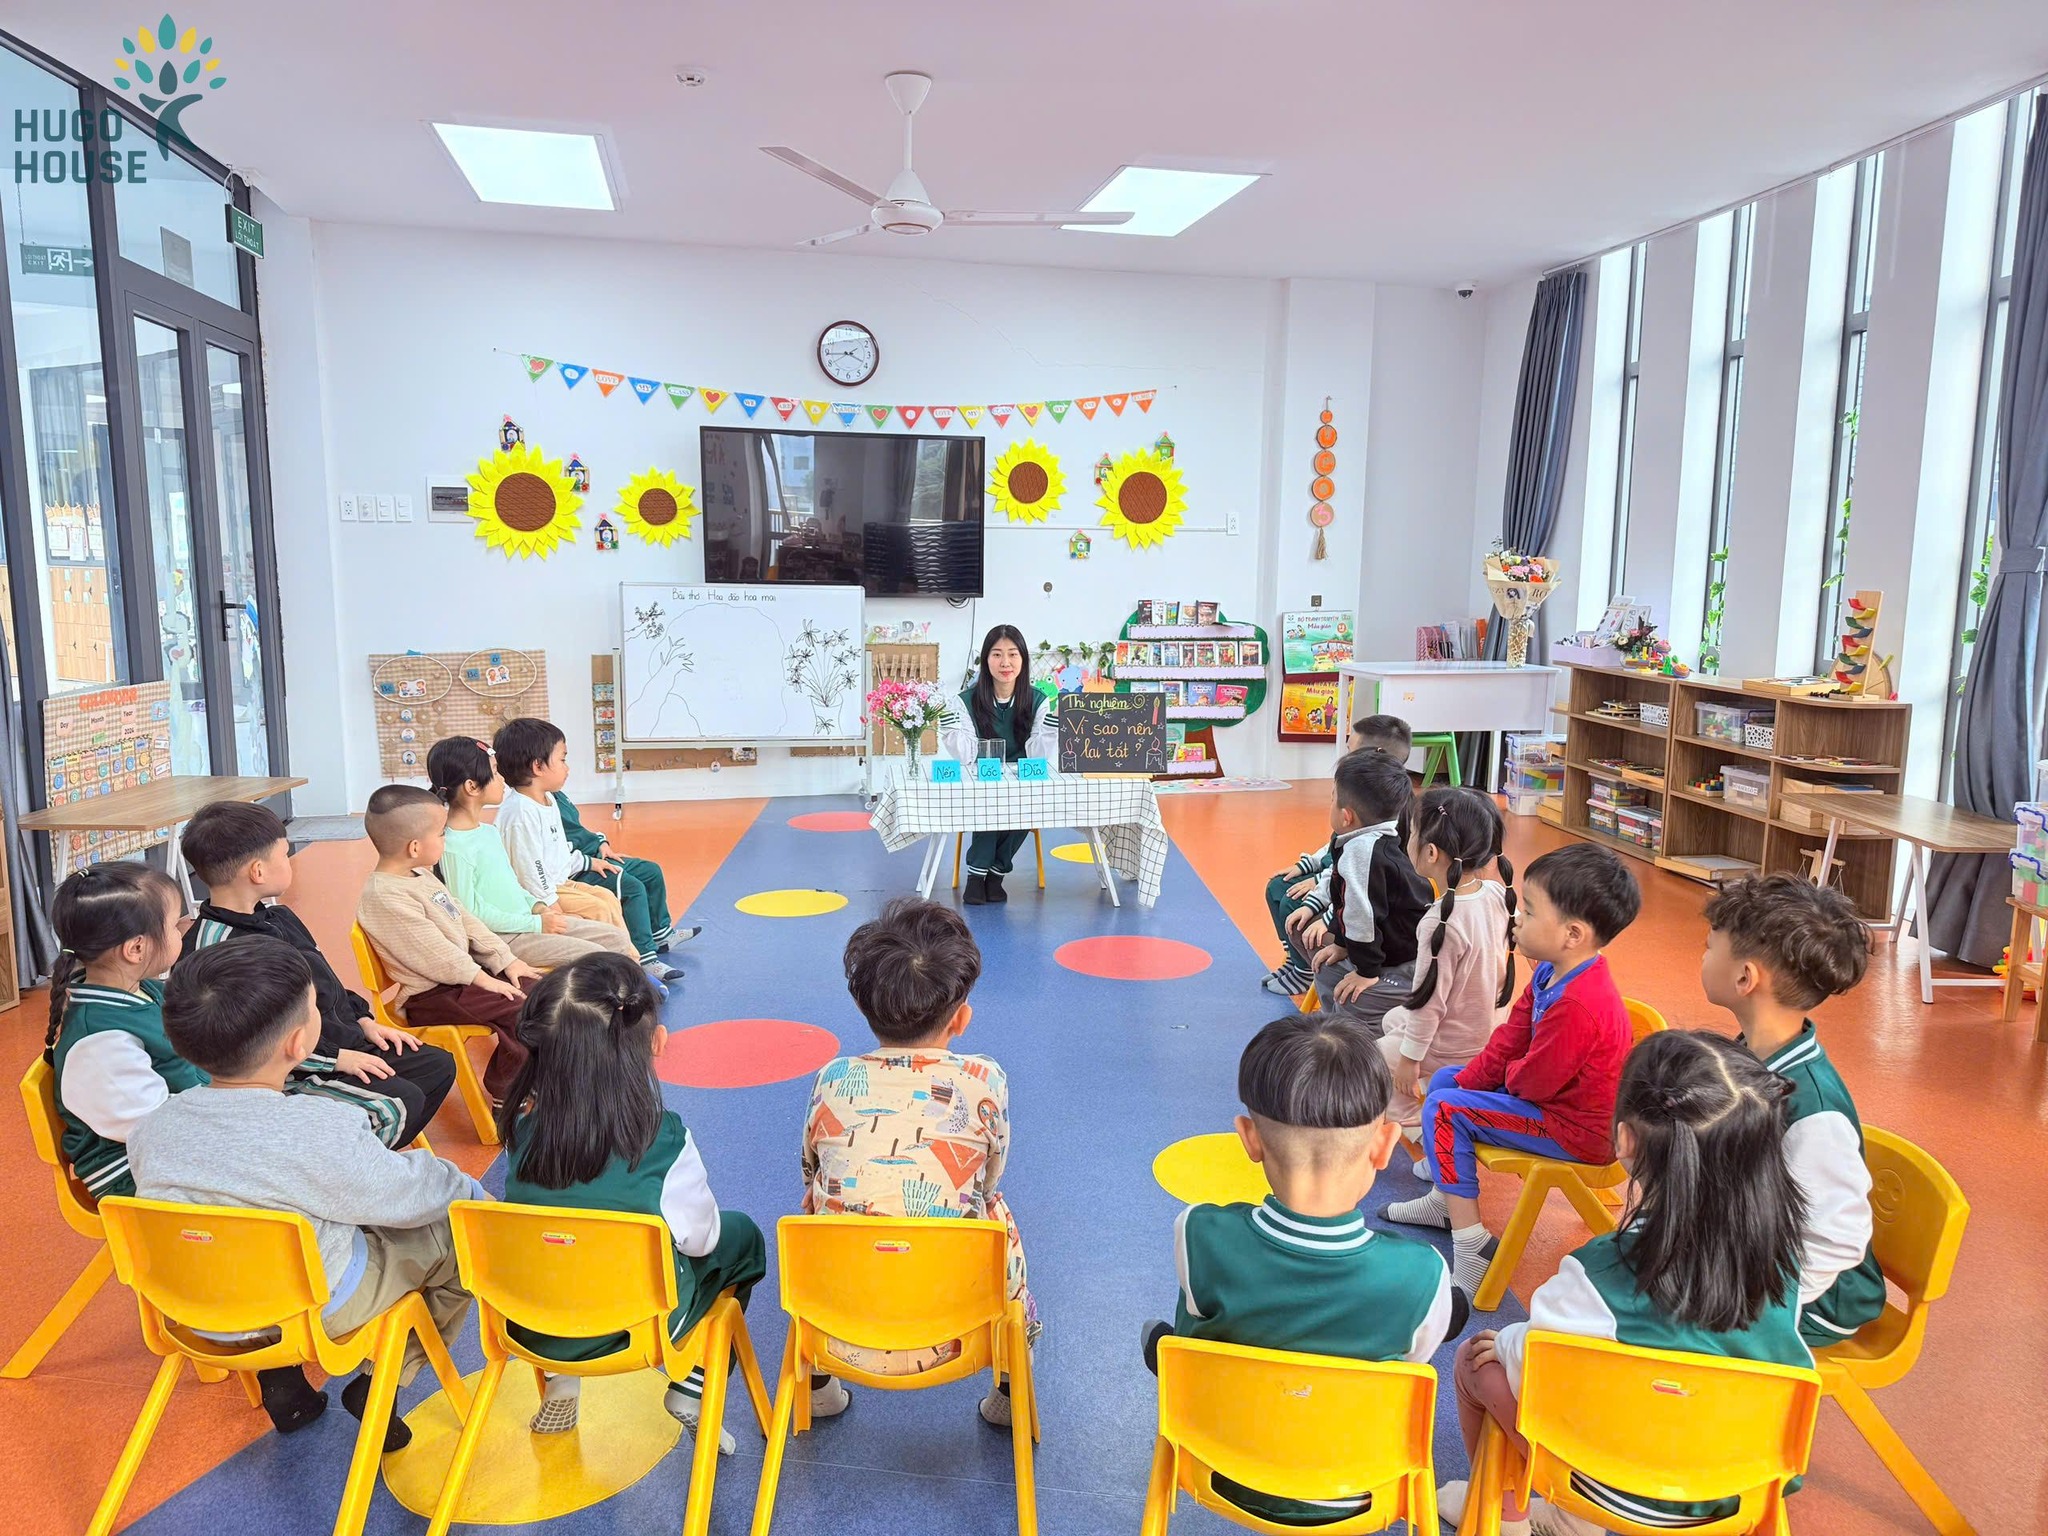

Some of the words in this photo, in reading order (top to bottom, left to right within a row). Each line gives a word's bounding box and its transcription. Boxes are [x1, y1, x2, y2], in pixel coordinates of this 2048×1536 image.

[237, 216, 255, 235] EXIT
[597, 375, 617, 384] LOVE
[638, 383, 650, 393] MY
[708, 589, 724, 601] Hoa
[744, 589, 757, 601] hoa
[761, 594, 777, 602] mai
[1062, 693, 1090, 709] Thí
[123, 710, 134, 718] Year
[1093, 724, 1119, 736] sao
[1127, 719, 1154, 736] nến
[936, 766, 956, 780] Nến
[980, 764, 998, 778] Cốc
[1020, 763, 1045, 778] Đĩa
